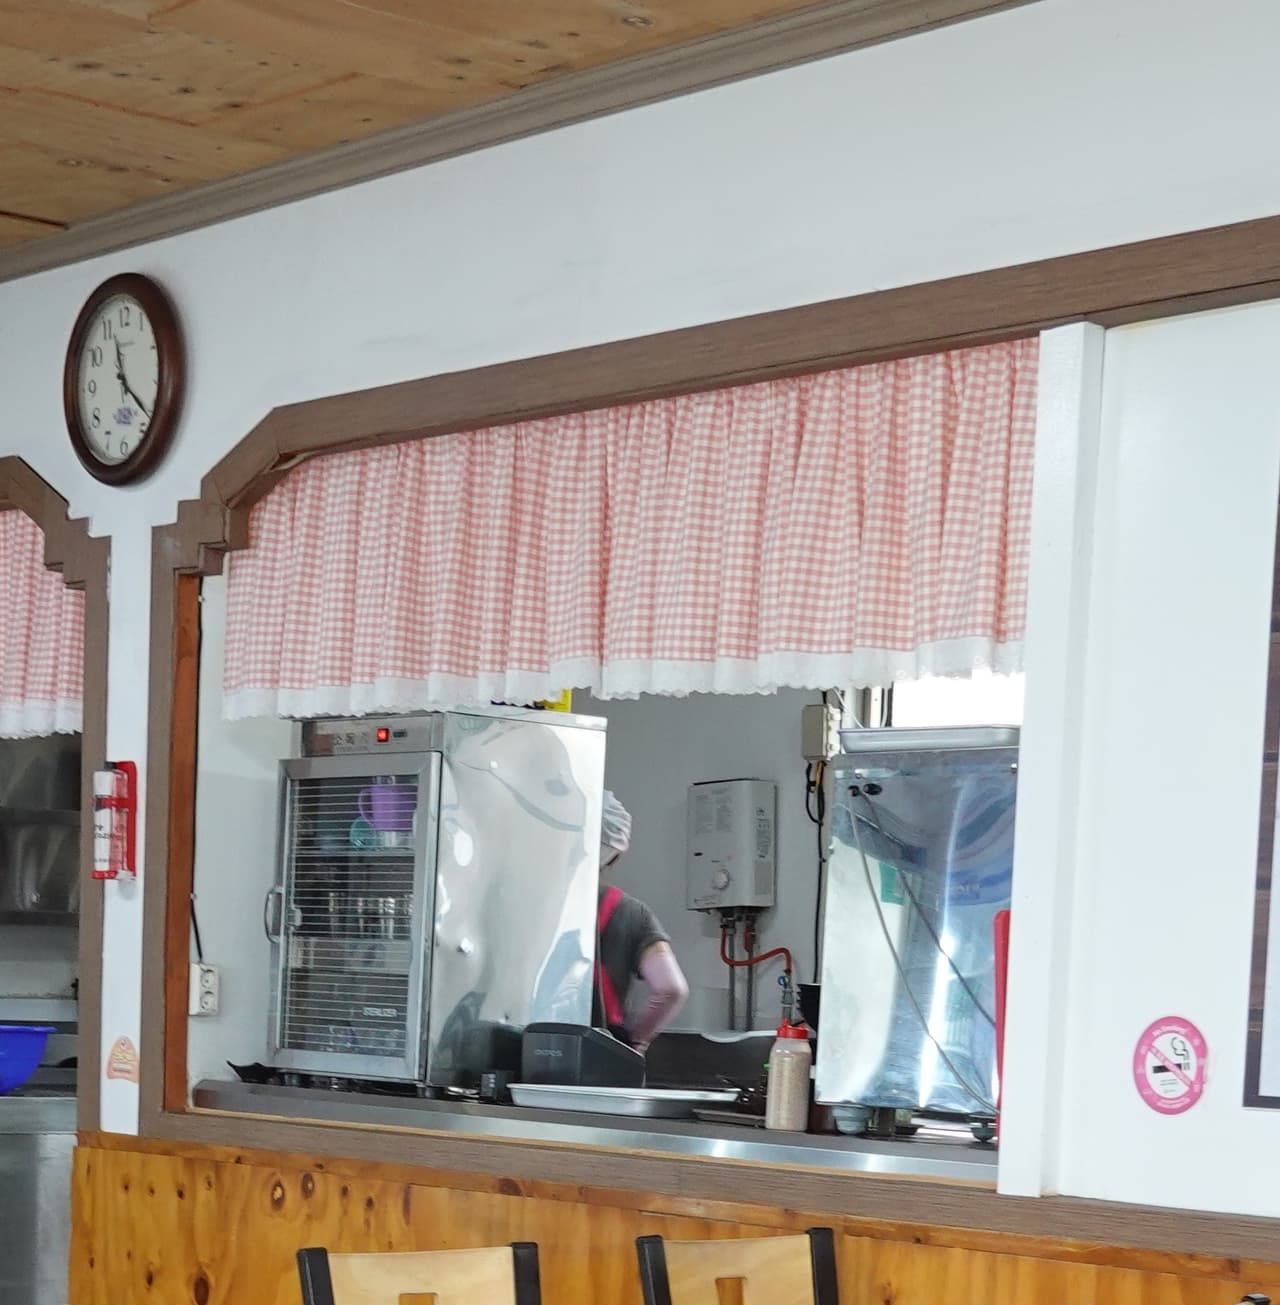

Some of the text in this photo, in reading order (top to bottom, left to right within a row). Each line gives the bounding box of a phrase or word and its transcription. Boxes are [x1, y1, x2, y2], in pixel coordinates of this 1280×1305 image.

[120, 306, 130, 328] 12
[102, 318, 112, 341] 11
[89, 345, 103, 367] 10
